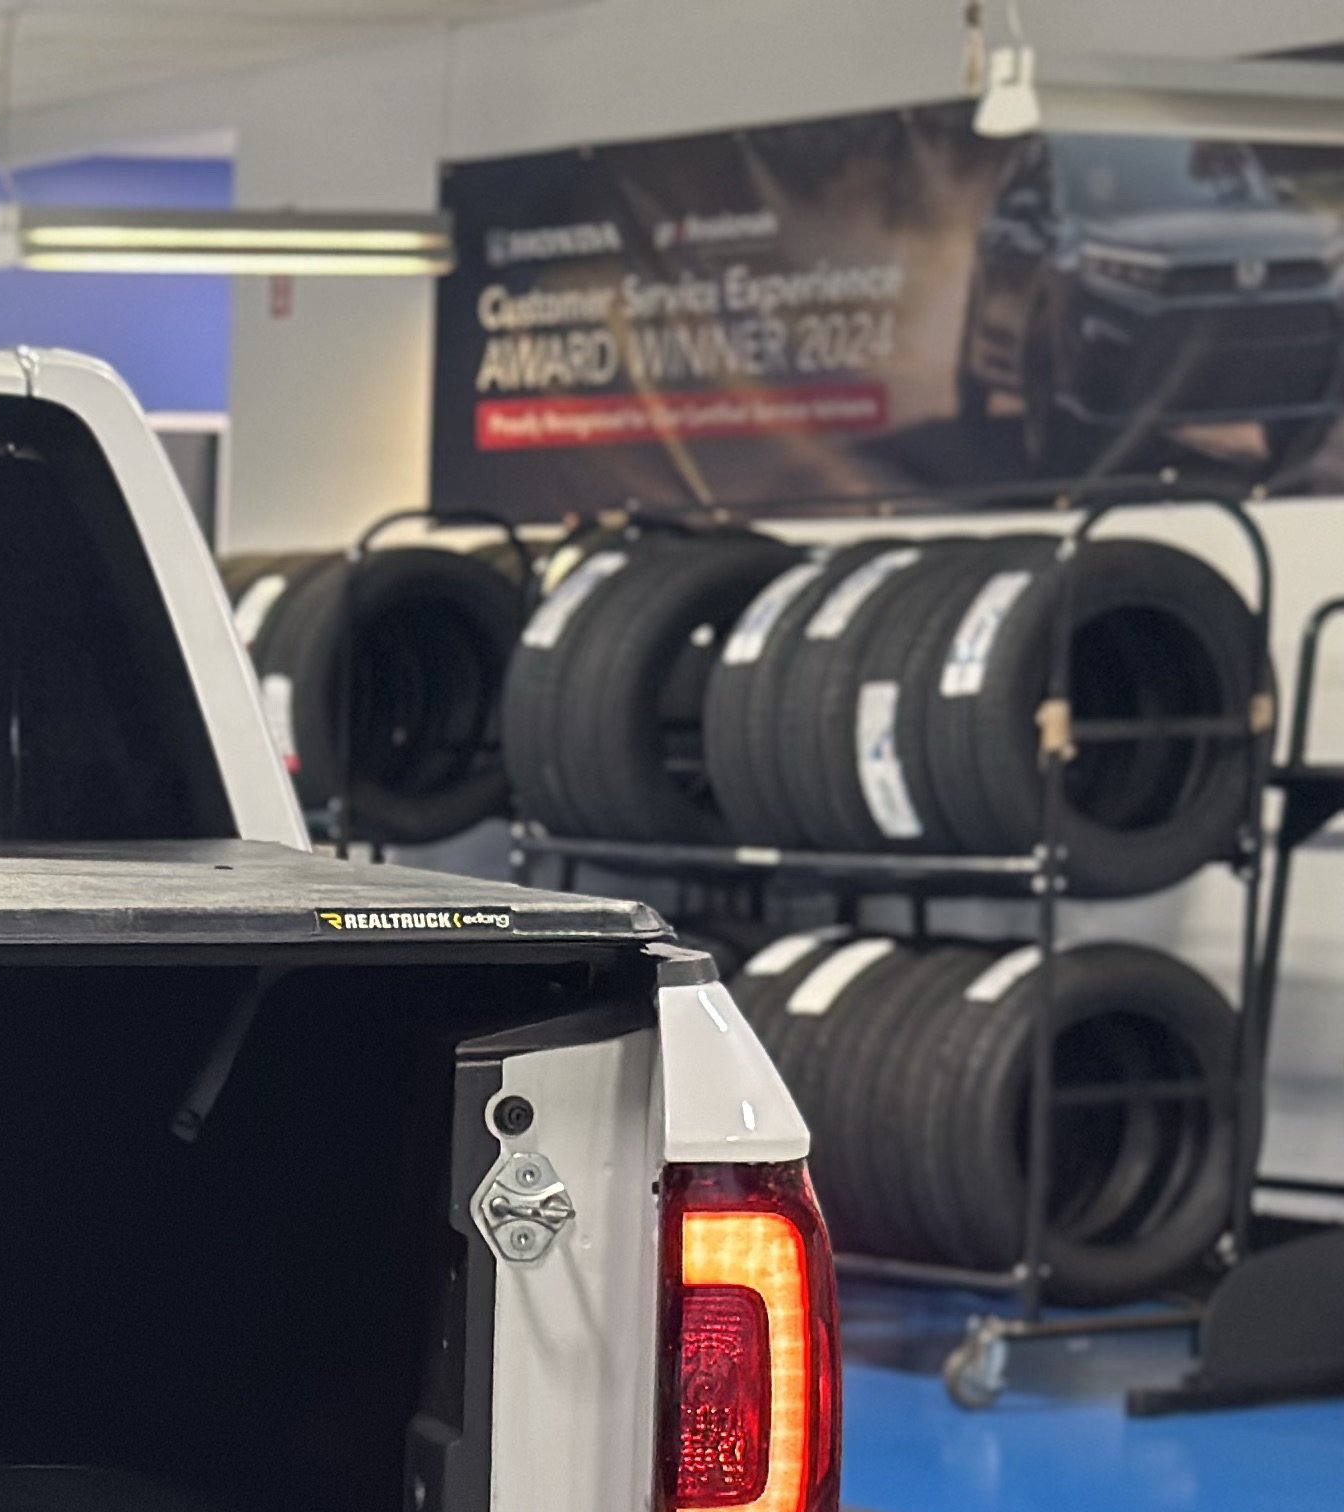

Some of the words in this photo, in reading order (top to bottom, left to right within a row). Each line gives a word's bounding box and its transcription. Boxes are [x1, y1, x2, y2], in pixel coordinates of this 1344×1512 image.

[475, 330, 616, 392] AWARD
[626, 319, 789, 381] WINNER
[797, 311, 897, 373] 2024
[345, 912, 452, 929] REALTRUCK
